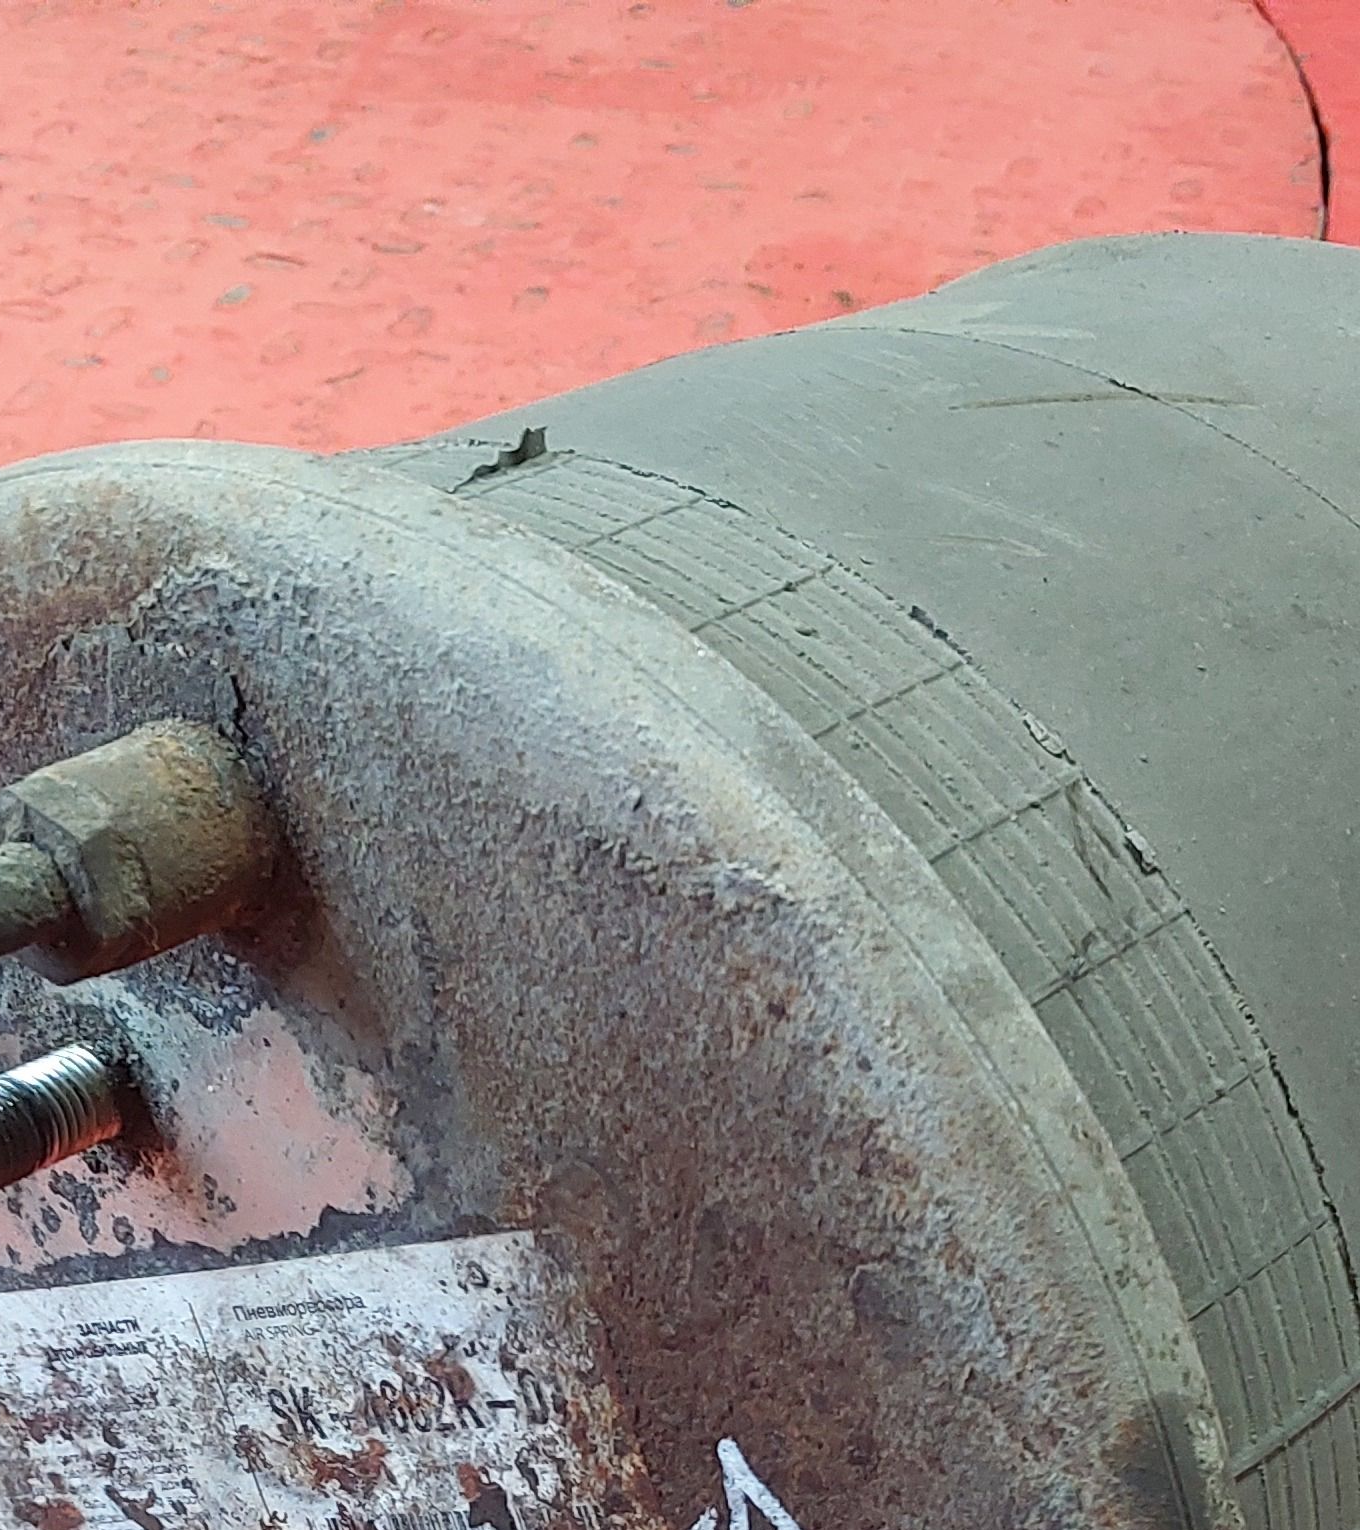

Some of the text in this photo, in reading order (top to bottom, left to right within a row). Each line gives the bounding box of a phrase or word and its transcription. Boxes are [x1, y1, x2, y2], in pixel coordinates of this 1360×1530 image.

[232, 1293, 367, 1321] Пневморессора
[78, 1318, 141, 1337] ЗАПЧАСТИ
[44, 1340, 148, 1364] ТОМОБИЛЬНЫЕ
